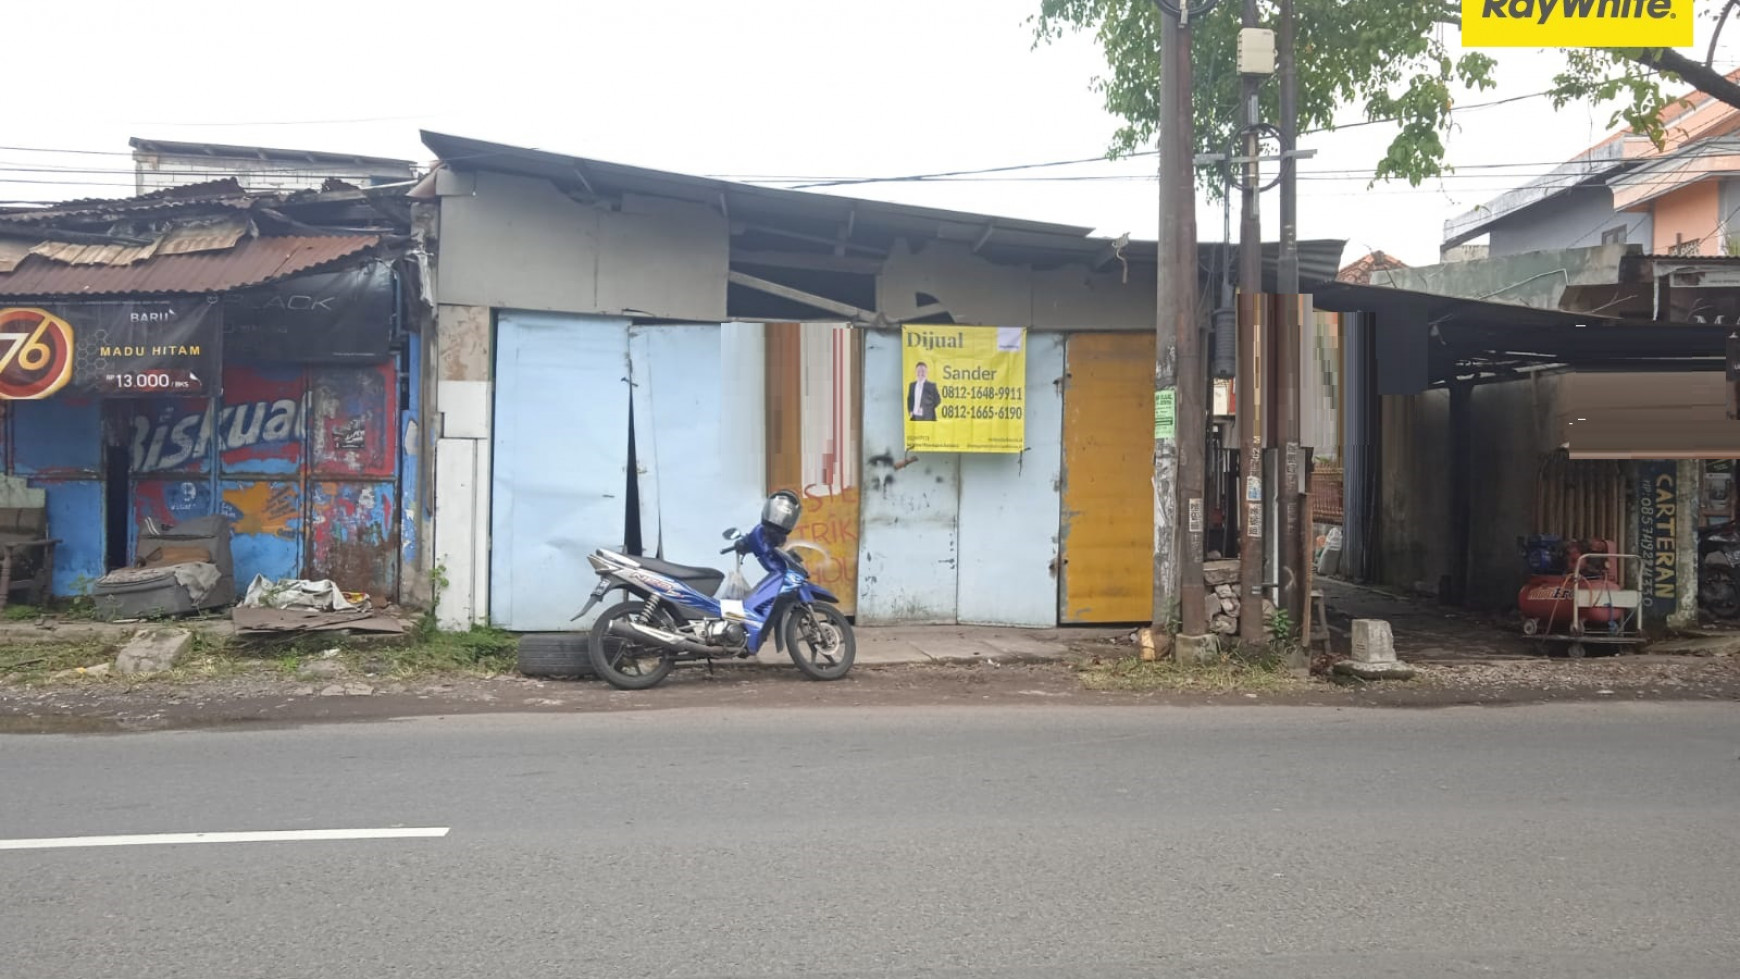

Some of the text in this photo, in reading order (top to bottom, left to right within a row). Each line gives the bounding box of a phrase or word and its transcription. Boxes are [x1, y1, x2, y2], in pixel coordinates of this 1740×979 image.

[906, 332, 964, 351] Dijual
[100, 345, 200, 357] MADU HITAM
[942, 365, 997, 381] Sander
[117, 374, 170, 388] 13.000
[941, 386, 1023, 400] 0812-1648-9911
[941, 405, 1023, 420] 0812-1665-6190
[1655, 473, 1676, 599] CARTERAN
